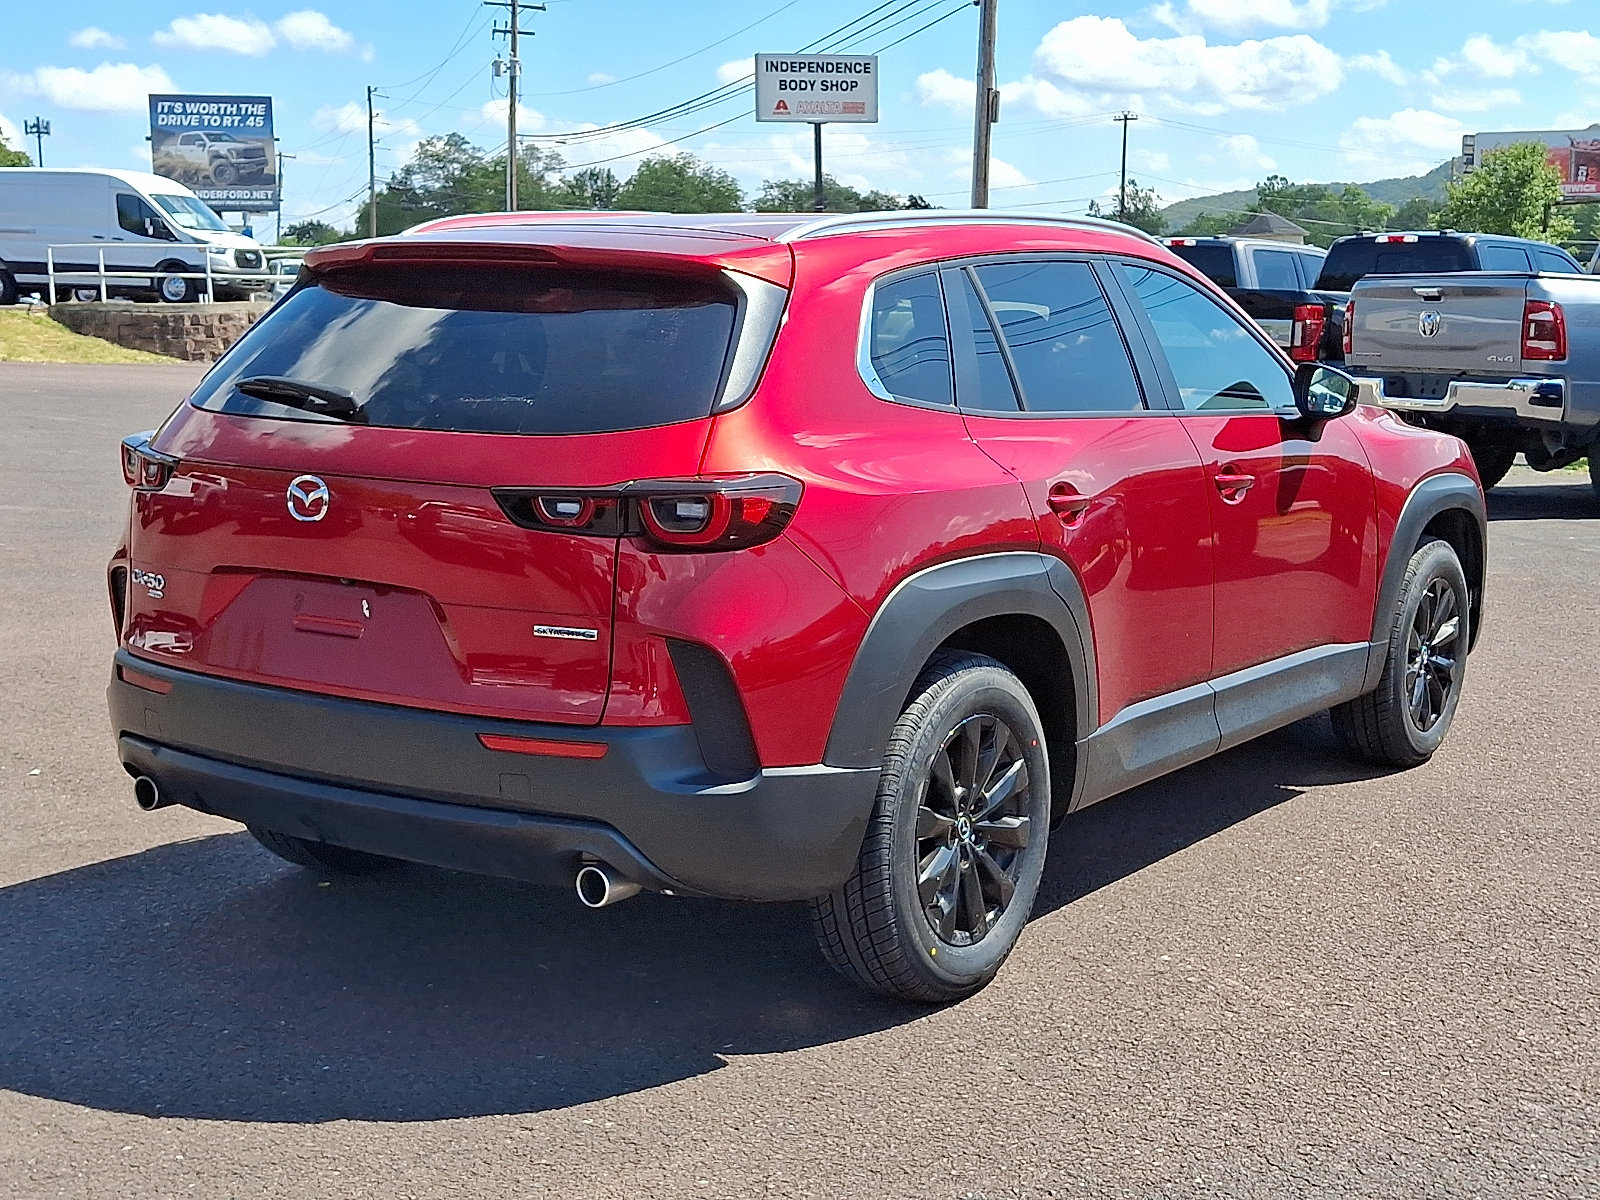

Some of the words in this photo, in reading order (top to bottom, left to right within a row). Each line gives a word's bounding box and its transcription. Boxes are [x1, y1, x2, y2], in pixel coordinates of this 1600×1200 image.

[765, 60, 872, 74] INDEPENDENCE
[778, 79, 817, 91] BODY
[820, 80, 859, 92] SHOP
[157, 101, 184, 114] IT'S
[185, 102, 237, 115] WORTH
[239, 103, 267, 115] THE
[796, 100, 841, 114] AXALTA
[158, 114, 200, 127] DRIVE
[202, 115, 220, 127] TO
[222, 116, 245, 128] RT.
[245, 116, 265, 128] 45
[195, 189, 274, 200] NDERFORD.NET
